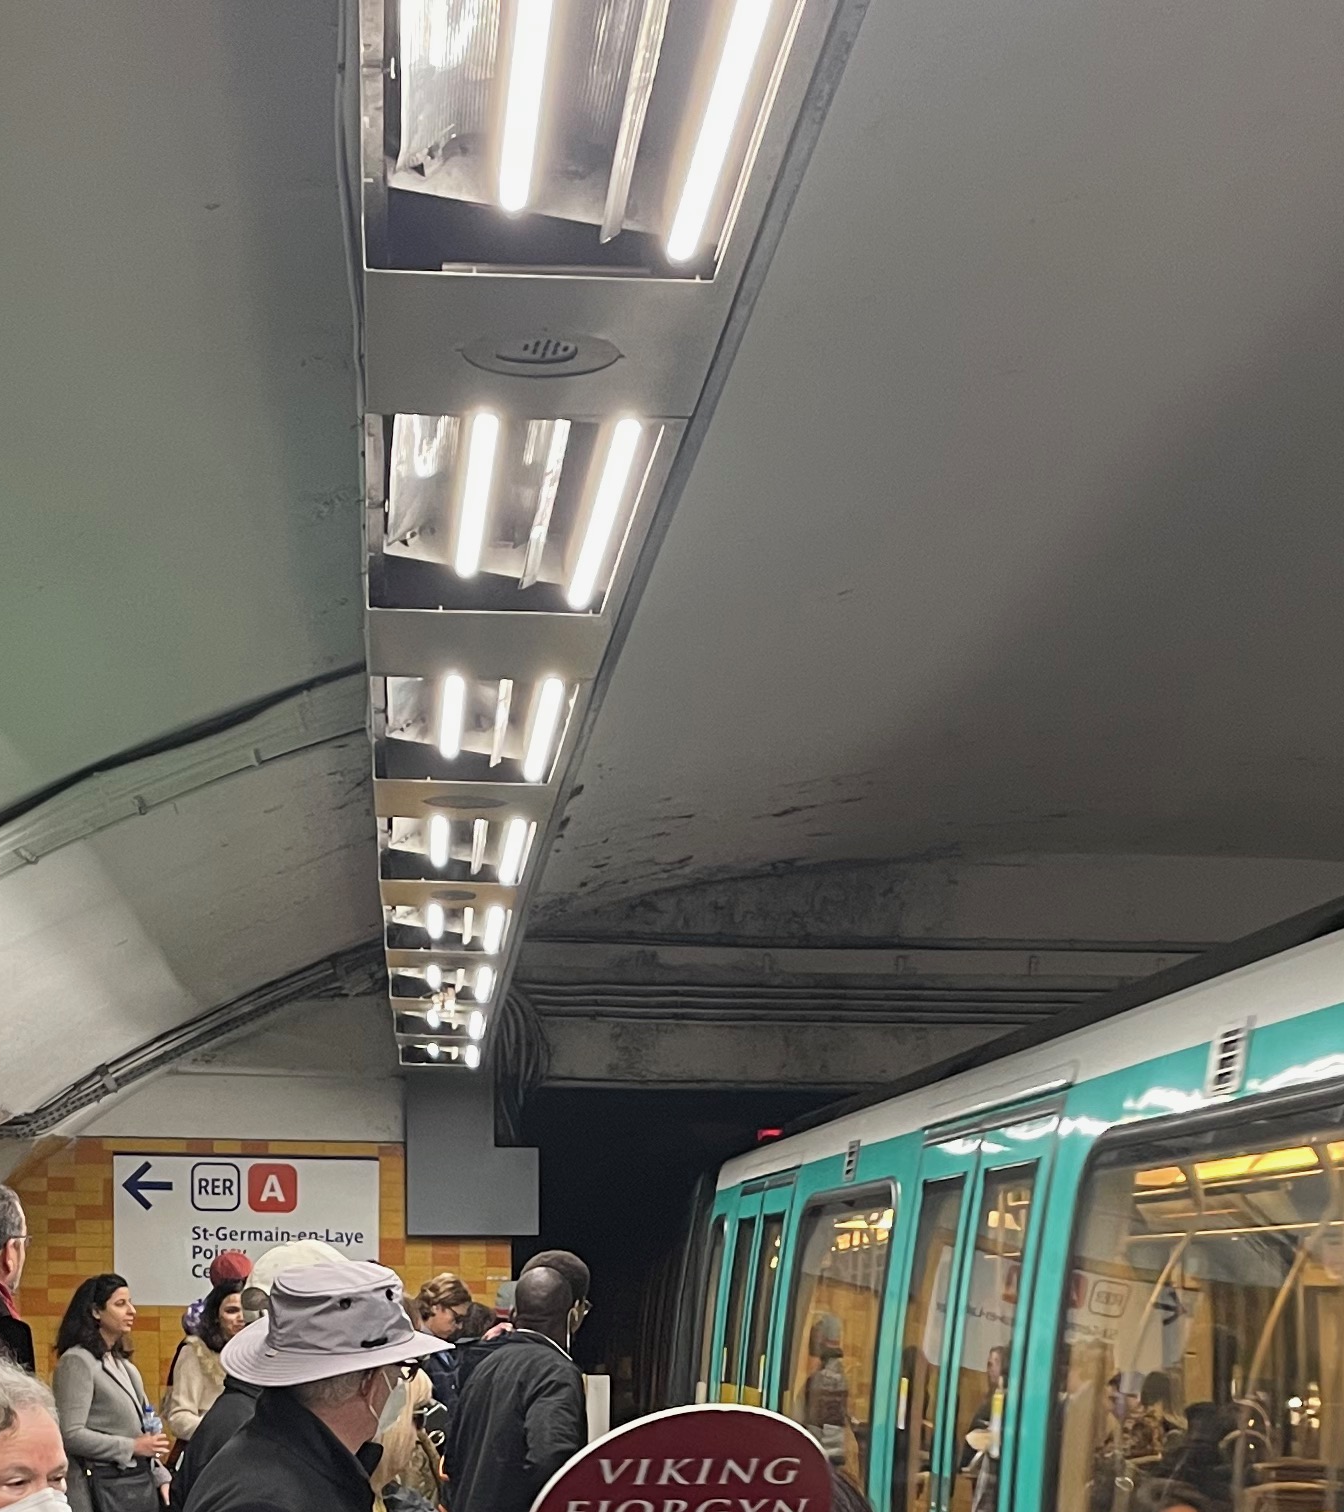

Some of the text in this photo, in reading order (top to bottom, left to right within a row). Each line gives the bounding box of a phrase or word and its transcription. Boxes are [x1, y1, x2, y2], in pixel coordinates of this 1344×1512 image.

[198, 1174, 286, 1202] RER A
[192, 1226, 364, 1247] St-Germain-en-Laye
[192, 1244, 247, 1260] Poi
[191, 1264, 211, 1279] Ce
[598, 1457, 801, 1485] VIKING
